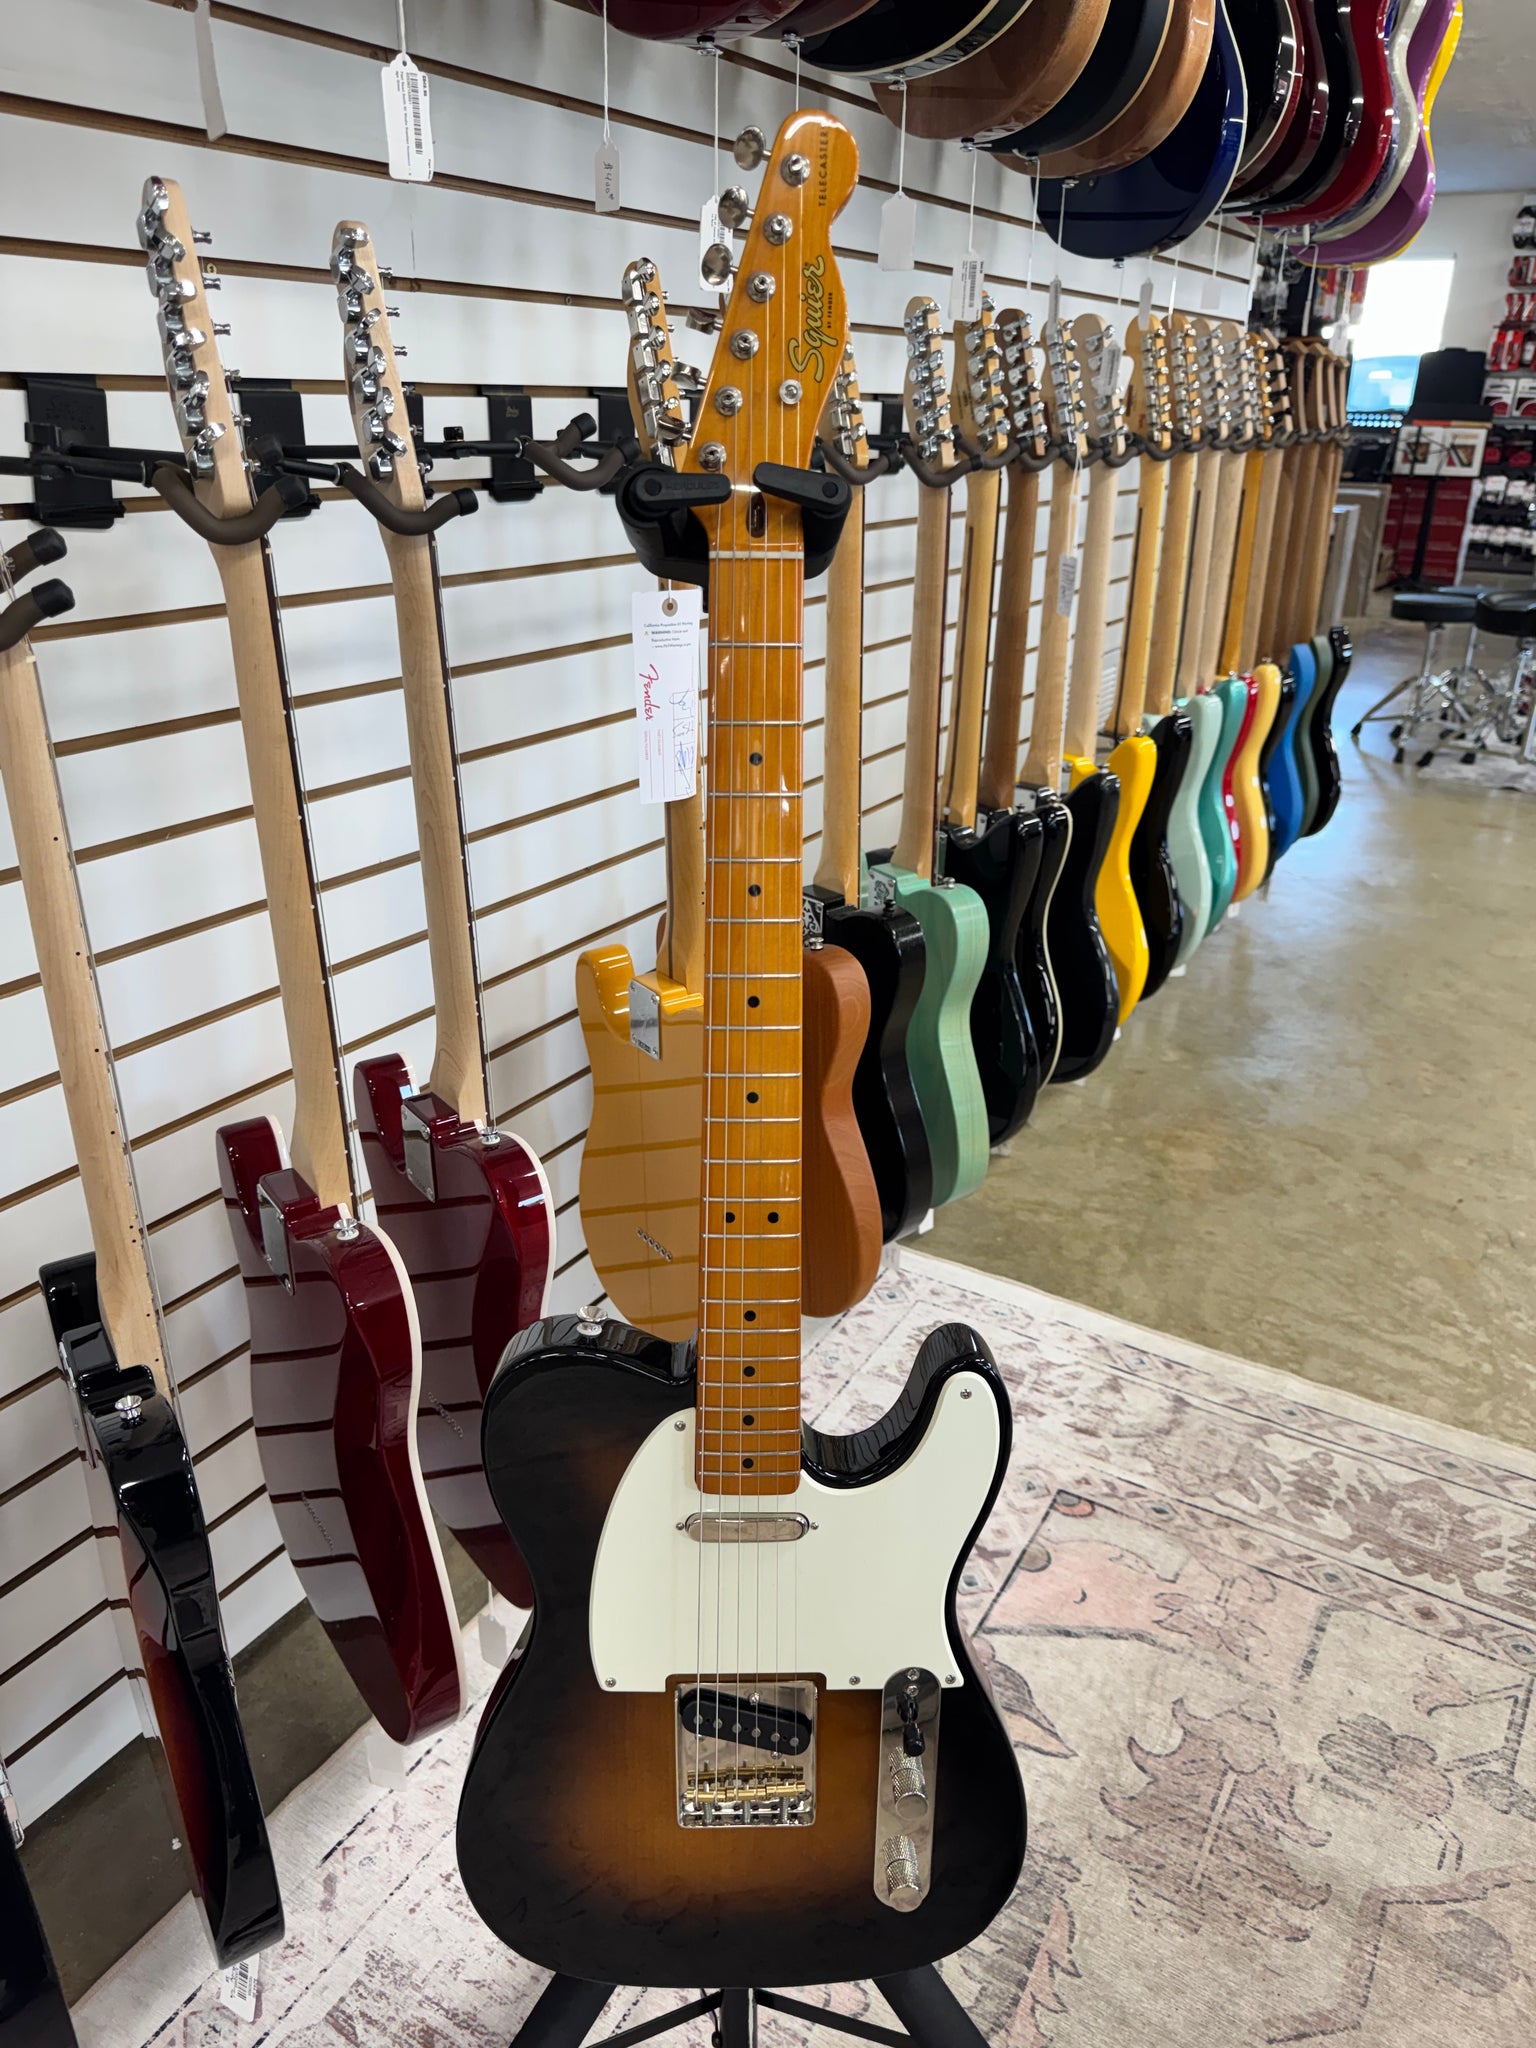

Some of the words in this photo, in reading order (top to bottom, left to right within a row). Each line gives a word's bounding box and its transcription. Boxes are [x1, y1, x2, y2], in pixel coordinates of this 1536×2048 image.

[818, 131, 828, 207] TELECASTER
[787, 255, 838, 383] Squier
[639, 663, 661, 722] Fender
